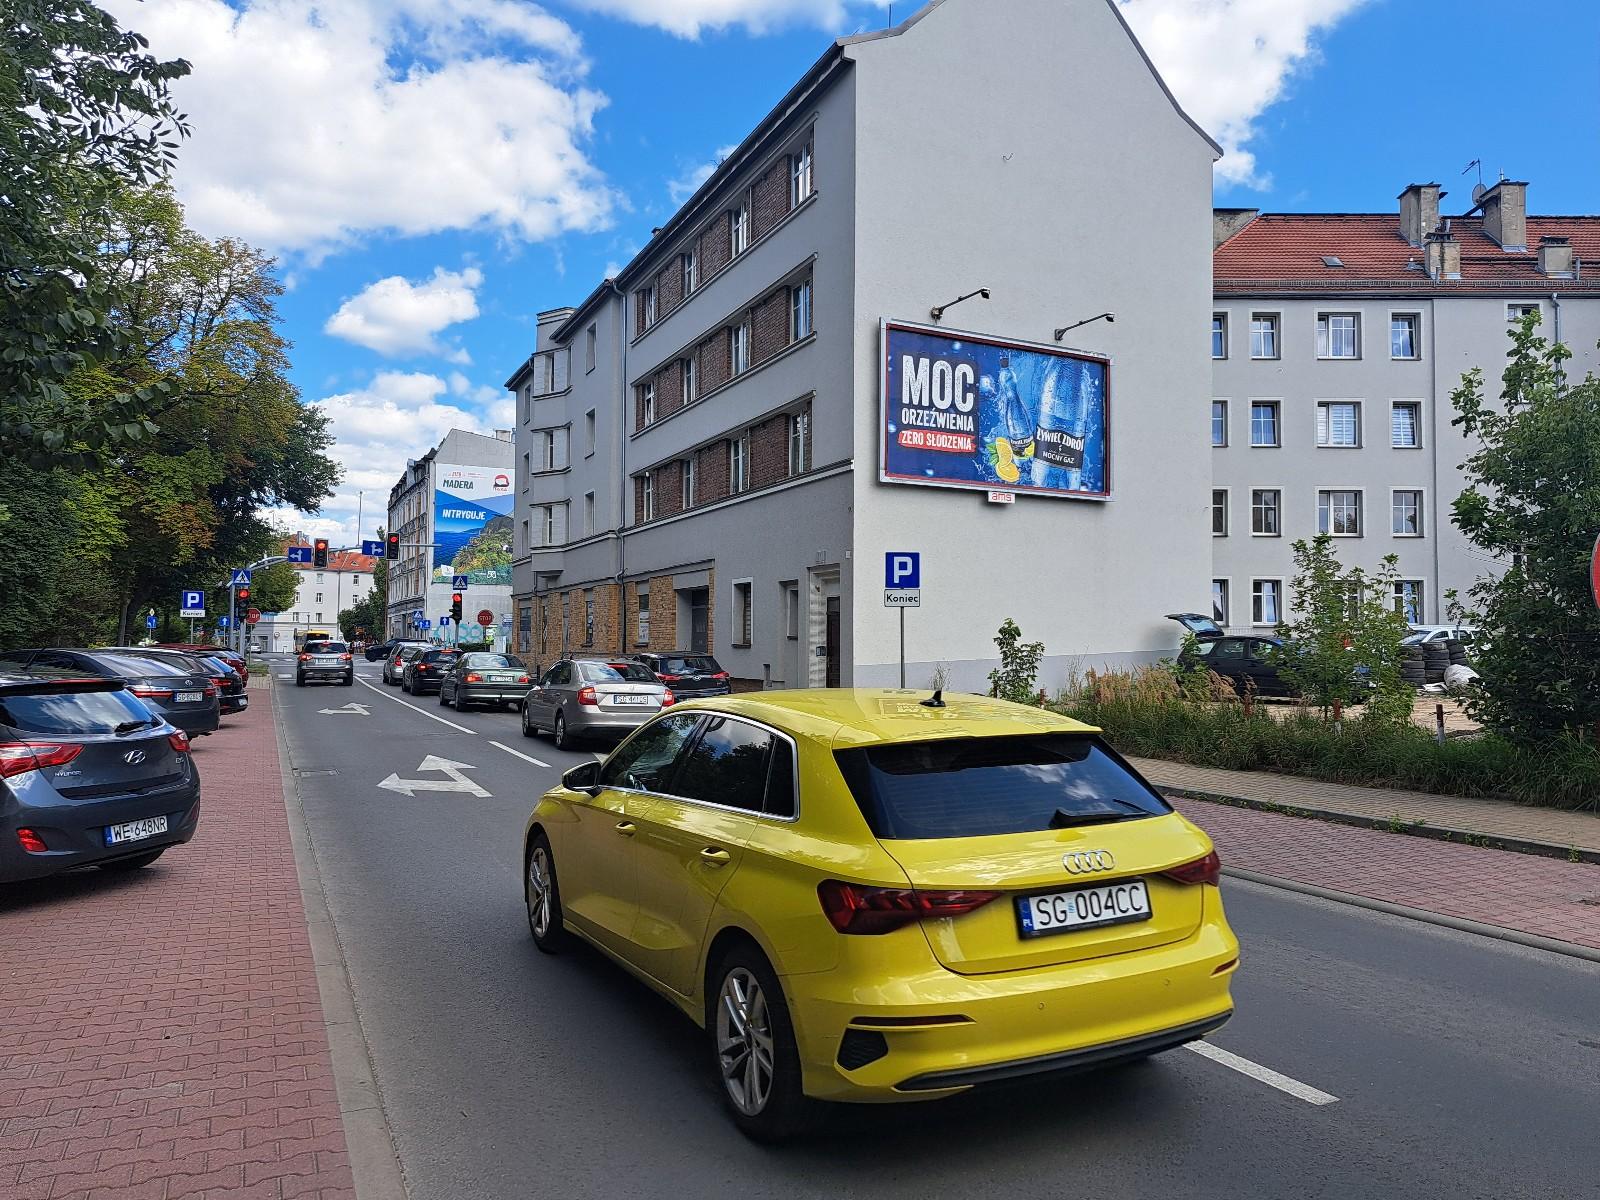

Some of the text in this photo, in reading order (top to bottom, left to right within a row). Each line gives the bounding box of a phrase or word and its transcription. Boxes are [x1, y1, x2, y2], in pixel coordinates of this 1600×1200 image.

[902, 354, 974, 412] MOC
[901, 407, 974, 432] ORZEŹWIENIA
[901, 430, 972, 450] ZERO SŁODZENIA
[1043, 451, 1062, 462] MOCNY
[442, 479, 474, 490] MADERA
[991, 492, 1012, 502] ams
[442, 509, 487, 520] INTRYGUJE
[893, 556, 913, 584] P
[187, 592, 200, 608] P
[886, 593, 919, 603] Koniec
[112, 815, 167, 841] WE 648NR
[1036, 885, 1143, 926] SG 004CC
